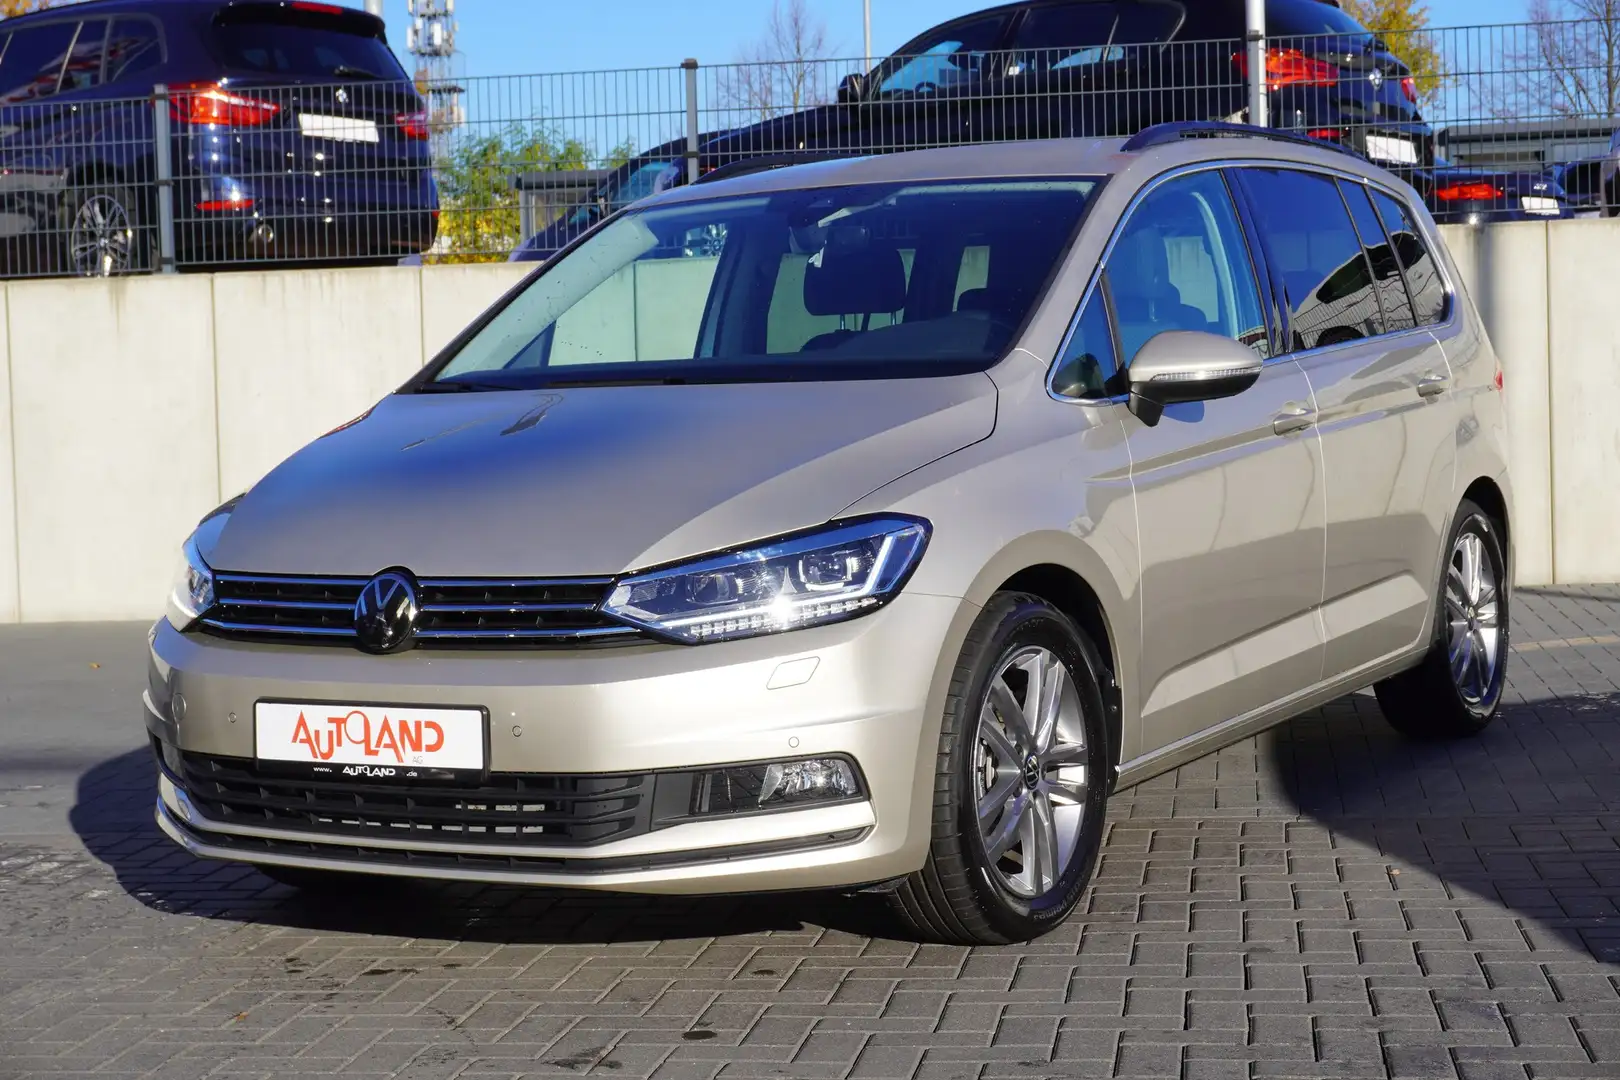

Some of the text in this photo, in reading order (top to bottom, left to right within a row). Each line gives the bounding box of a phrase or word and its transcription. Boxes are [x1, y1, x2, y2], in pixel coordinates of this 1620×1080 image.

[291, 710, 445, 764] AUTOLAND
[411, 755, 424, 765] AG
[342, 765, 396, 777] AUTOLAND
